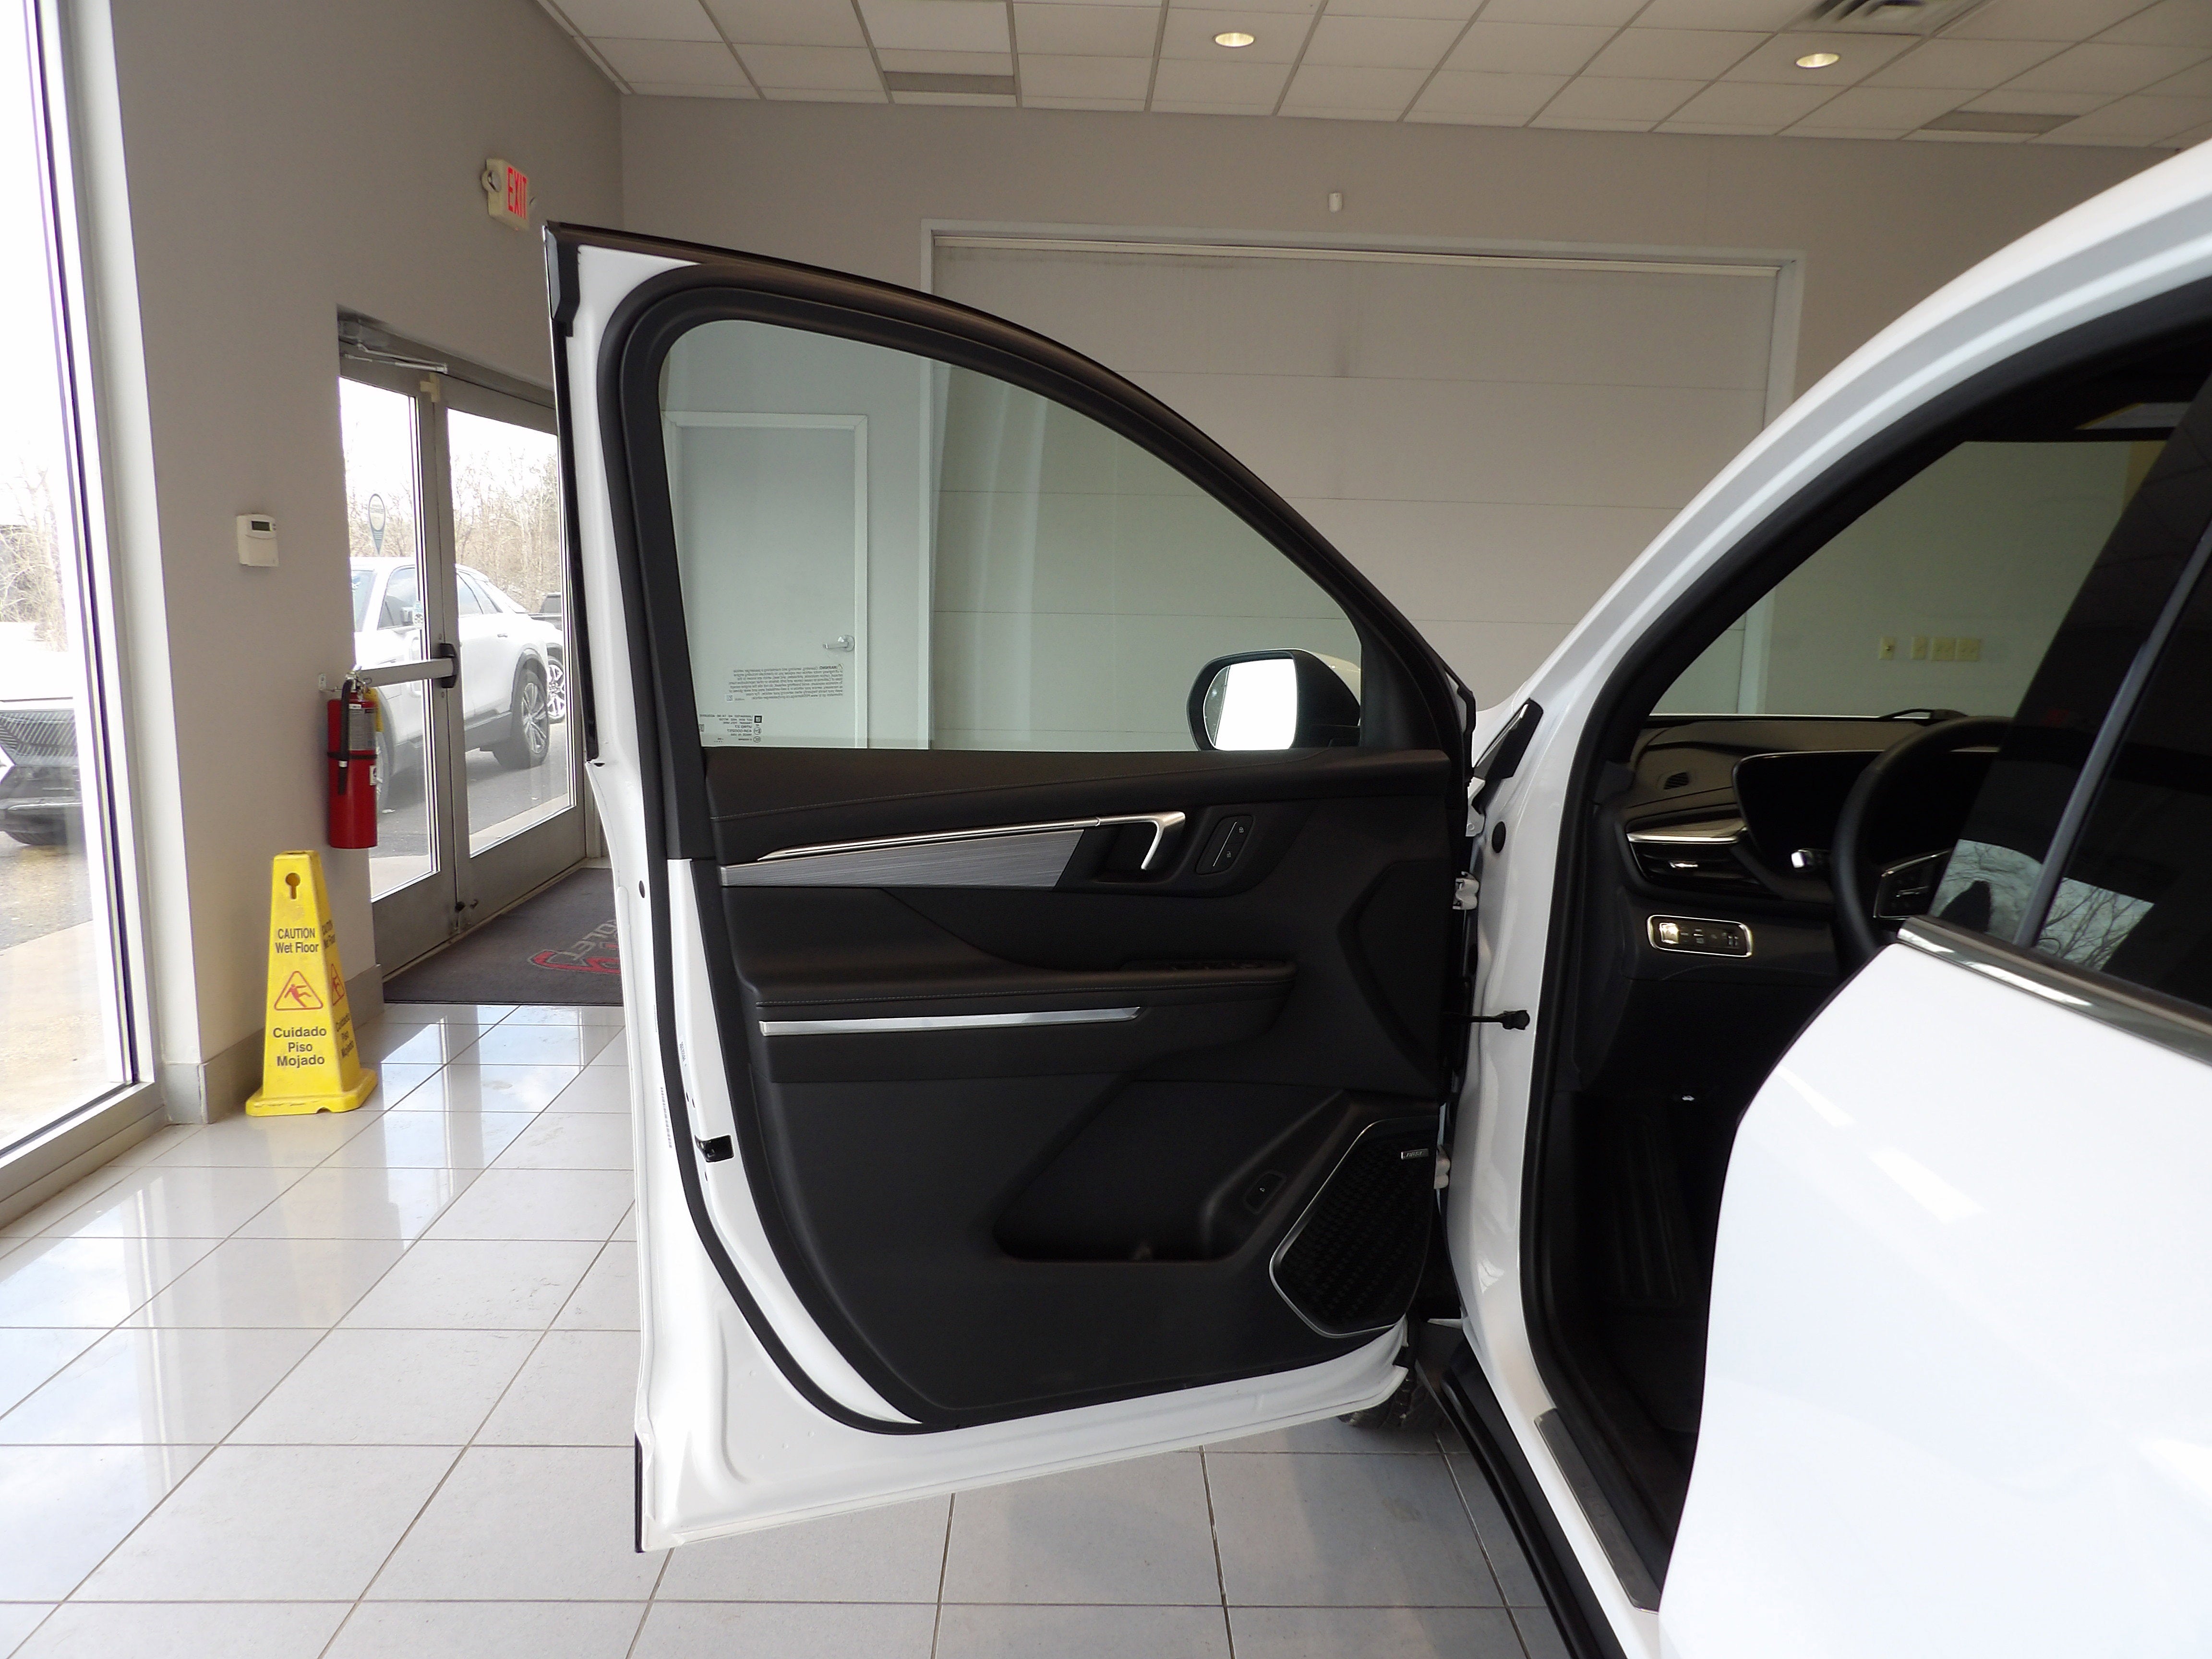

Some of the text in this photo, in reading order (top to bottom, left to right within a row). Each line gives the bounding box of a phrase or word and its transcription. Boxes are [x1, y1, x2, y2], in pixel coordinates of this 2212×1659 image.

[507, 167, 527, 219] EXIT
[277, 928, 315, 939] CAUTION
[275, 942, 319, 953] Wet Floor
[273, 1026, 327, 1038] Cuidado
[288, 1042, 313, 1052] Piso
[277, 1056, 325, 1069] Mojado
